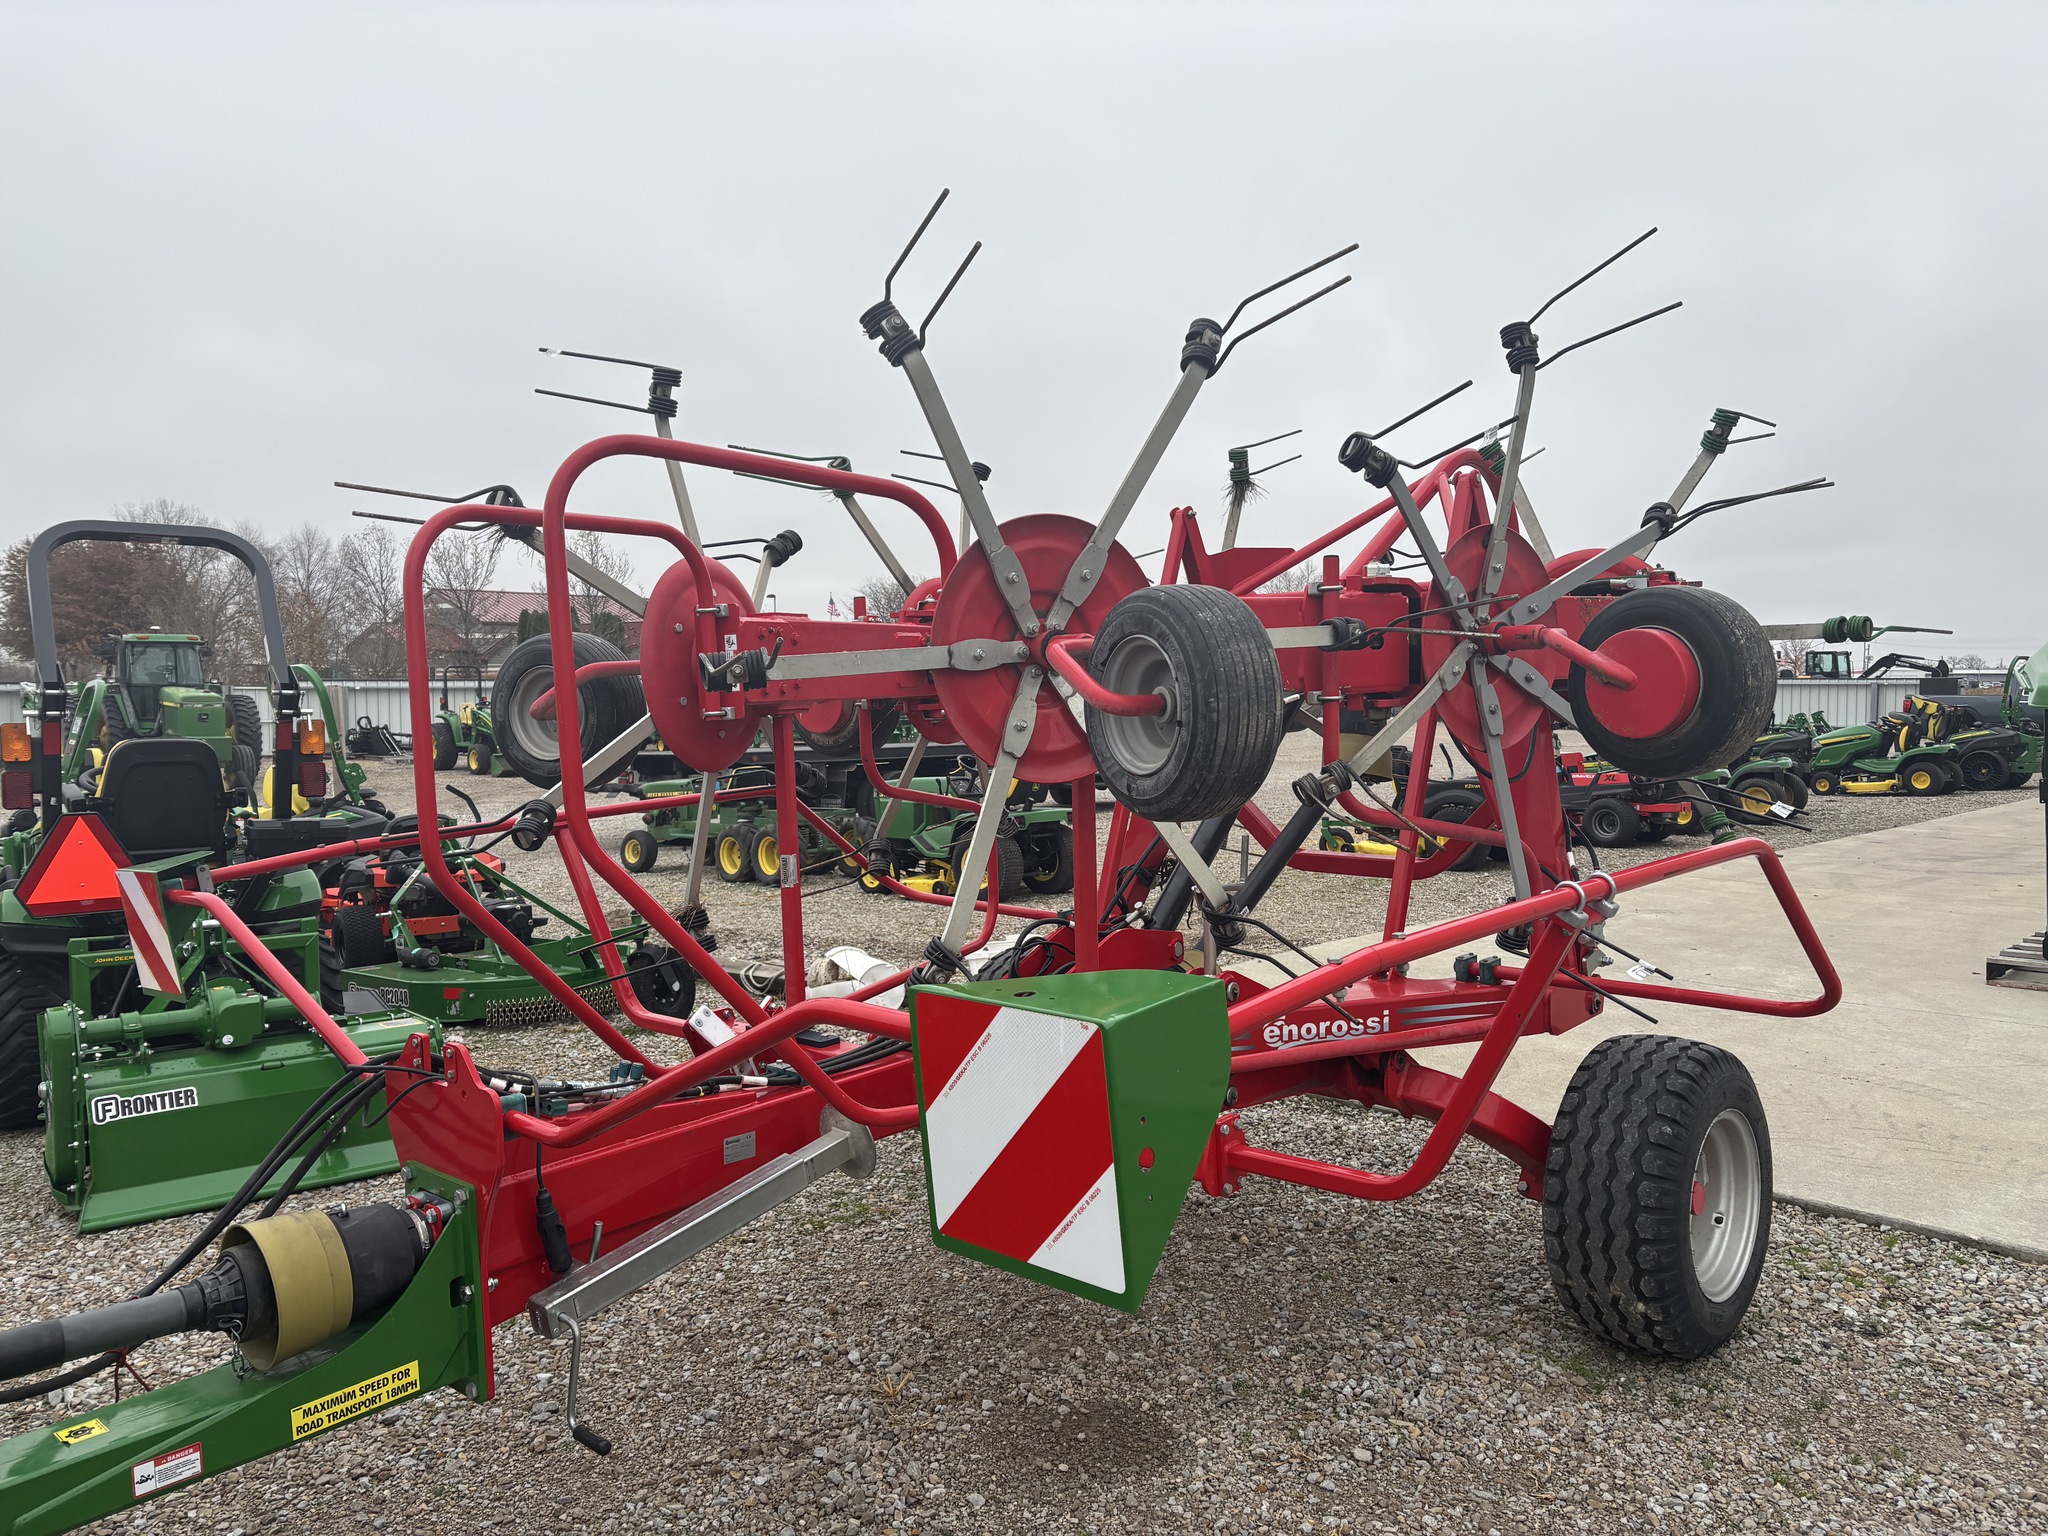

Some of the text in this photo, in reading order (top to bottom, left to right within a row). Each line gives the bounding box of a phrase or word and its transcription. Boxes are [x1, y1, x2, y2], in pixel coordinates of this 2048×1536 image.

[1604, 774, 1617, 782] XL
[1263, 1010, 1390, 1044] enorossi
[93, 1088, 197, 1123] FRONTIER
[295, 1379, 418, 1437] ROAD TRANSPORT 18MPH
[302, 1368, 411, 1419] MAXIMUM SPEED FOR
[167, 1448, 194, 1462] DANGER
